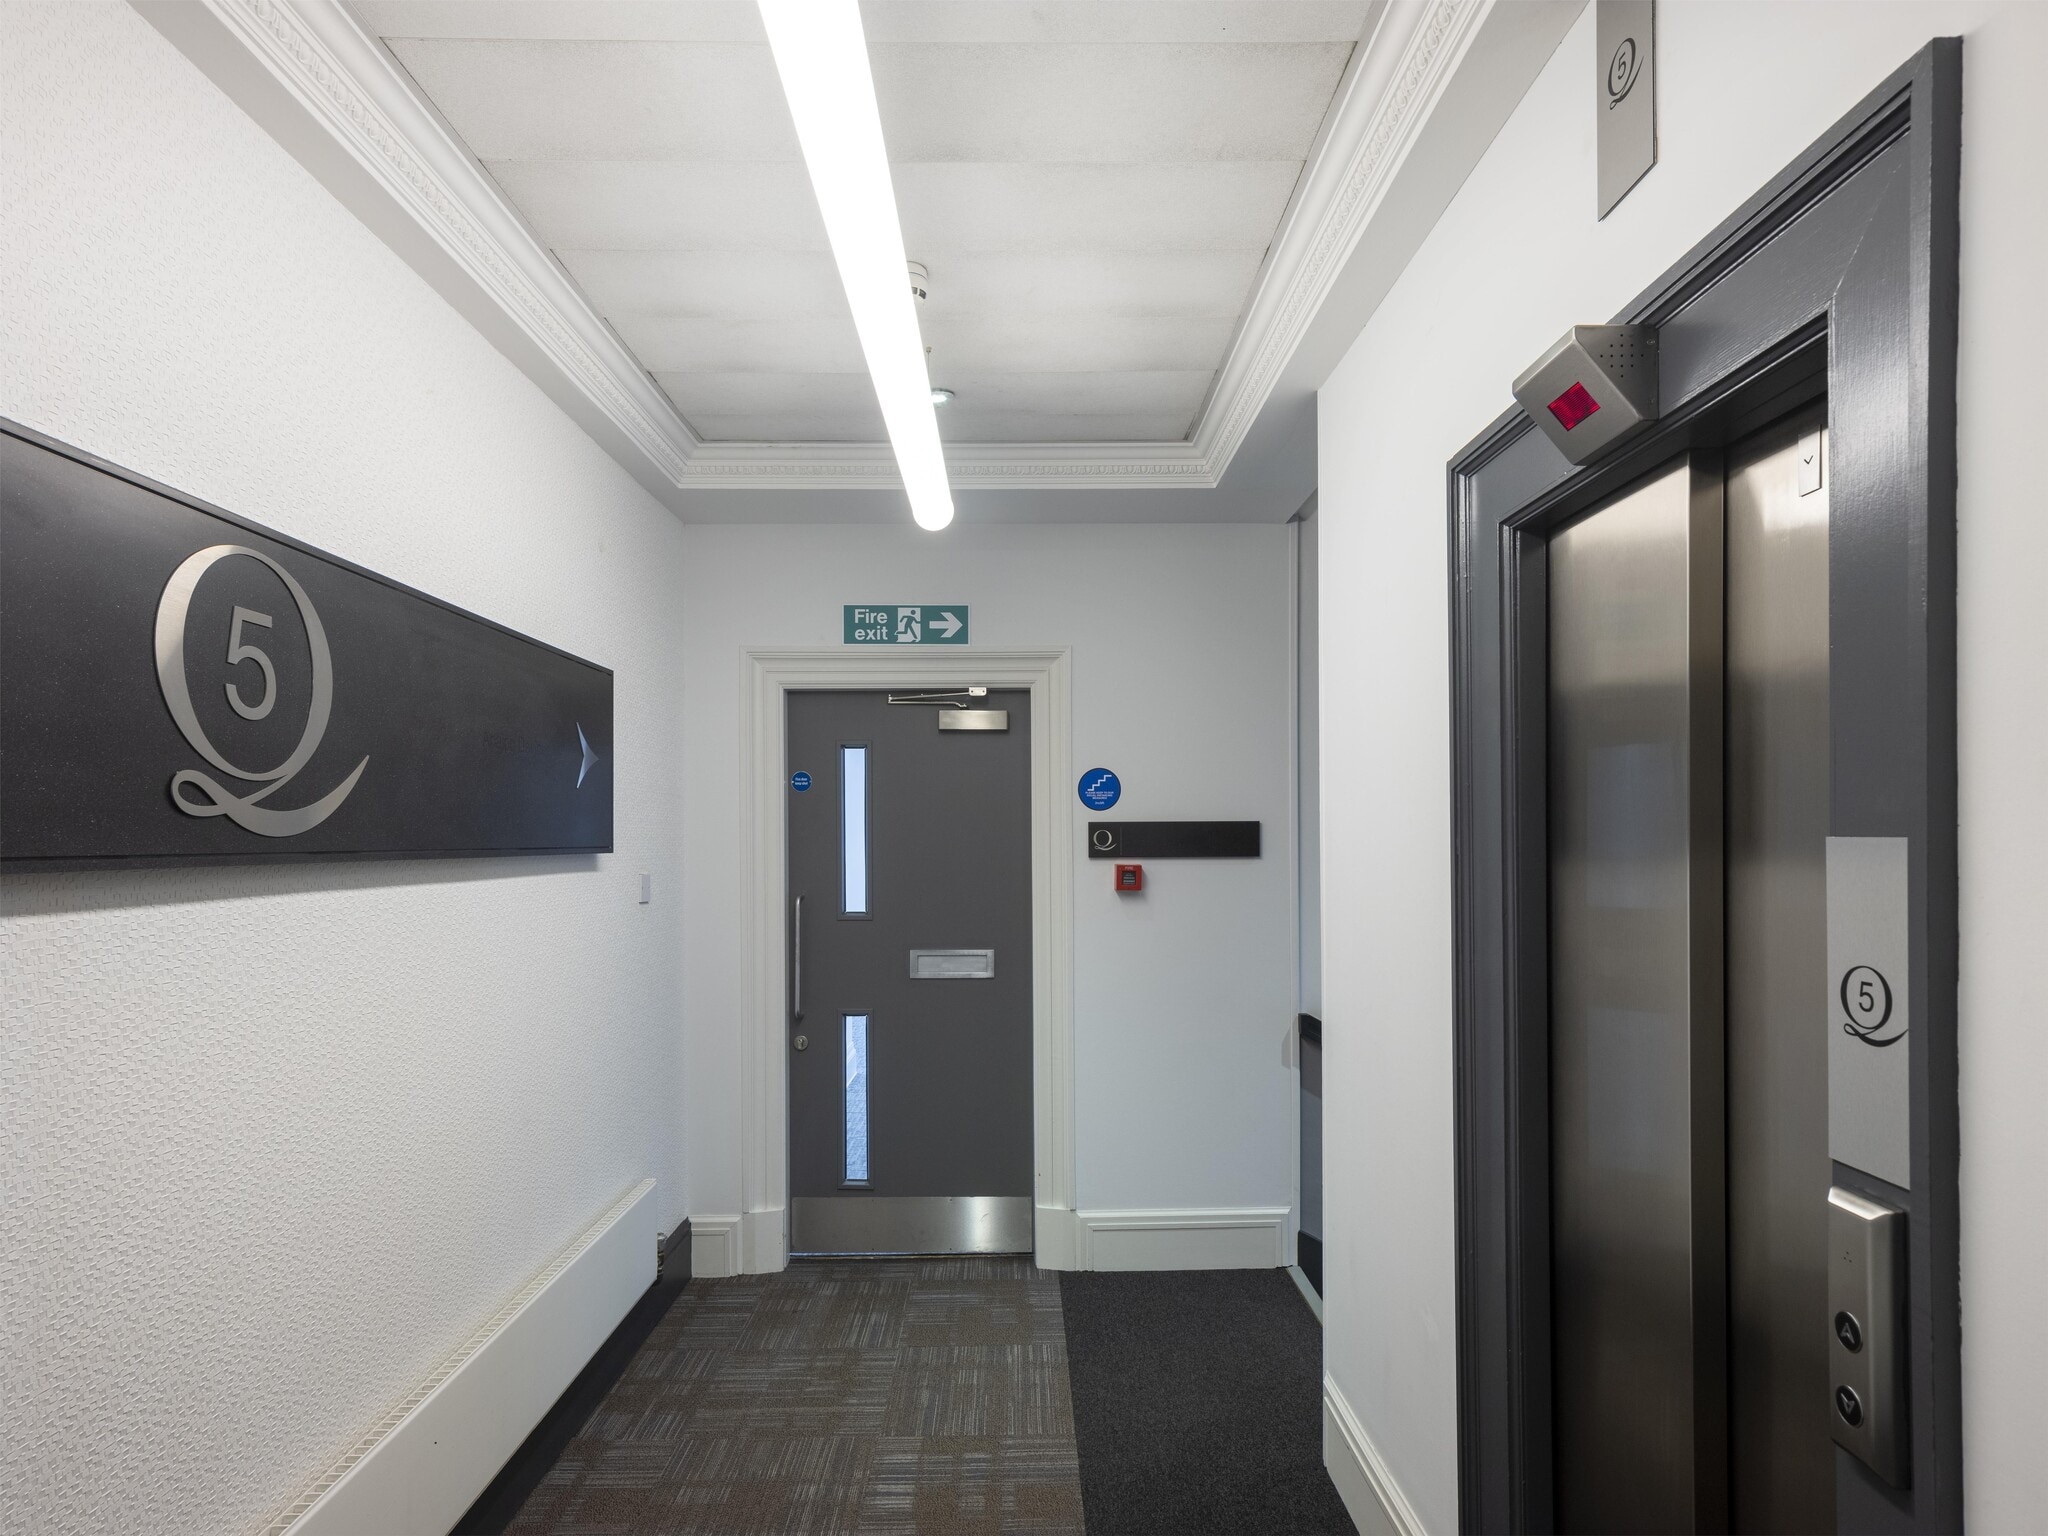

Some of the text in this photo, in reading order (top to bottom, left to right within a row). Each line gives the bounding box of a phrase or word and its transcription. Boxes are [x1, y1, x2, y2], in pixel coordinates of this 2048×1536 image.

[854, 608, 888, 624] Fire
[854, 625, 888, 641] exit
[225, 605, 277, 721] 5
[1093, 829, 1118, 851] Q
[1858, 980, 1875, 1013] 5
